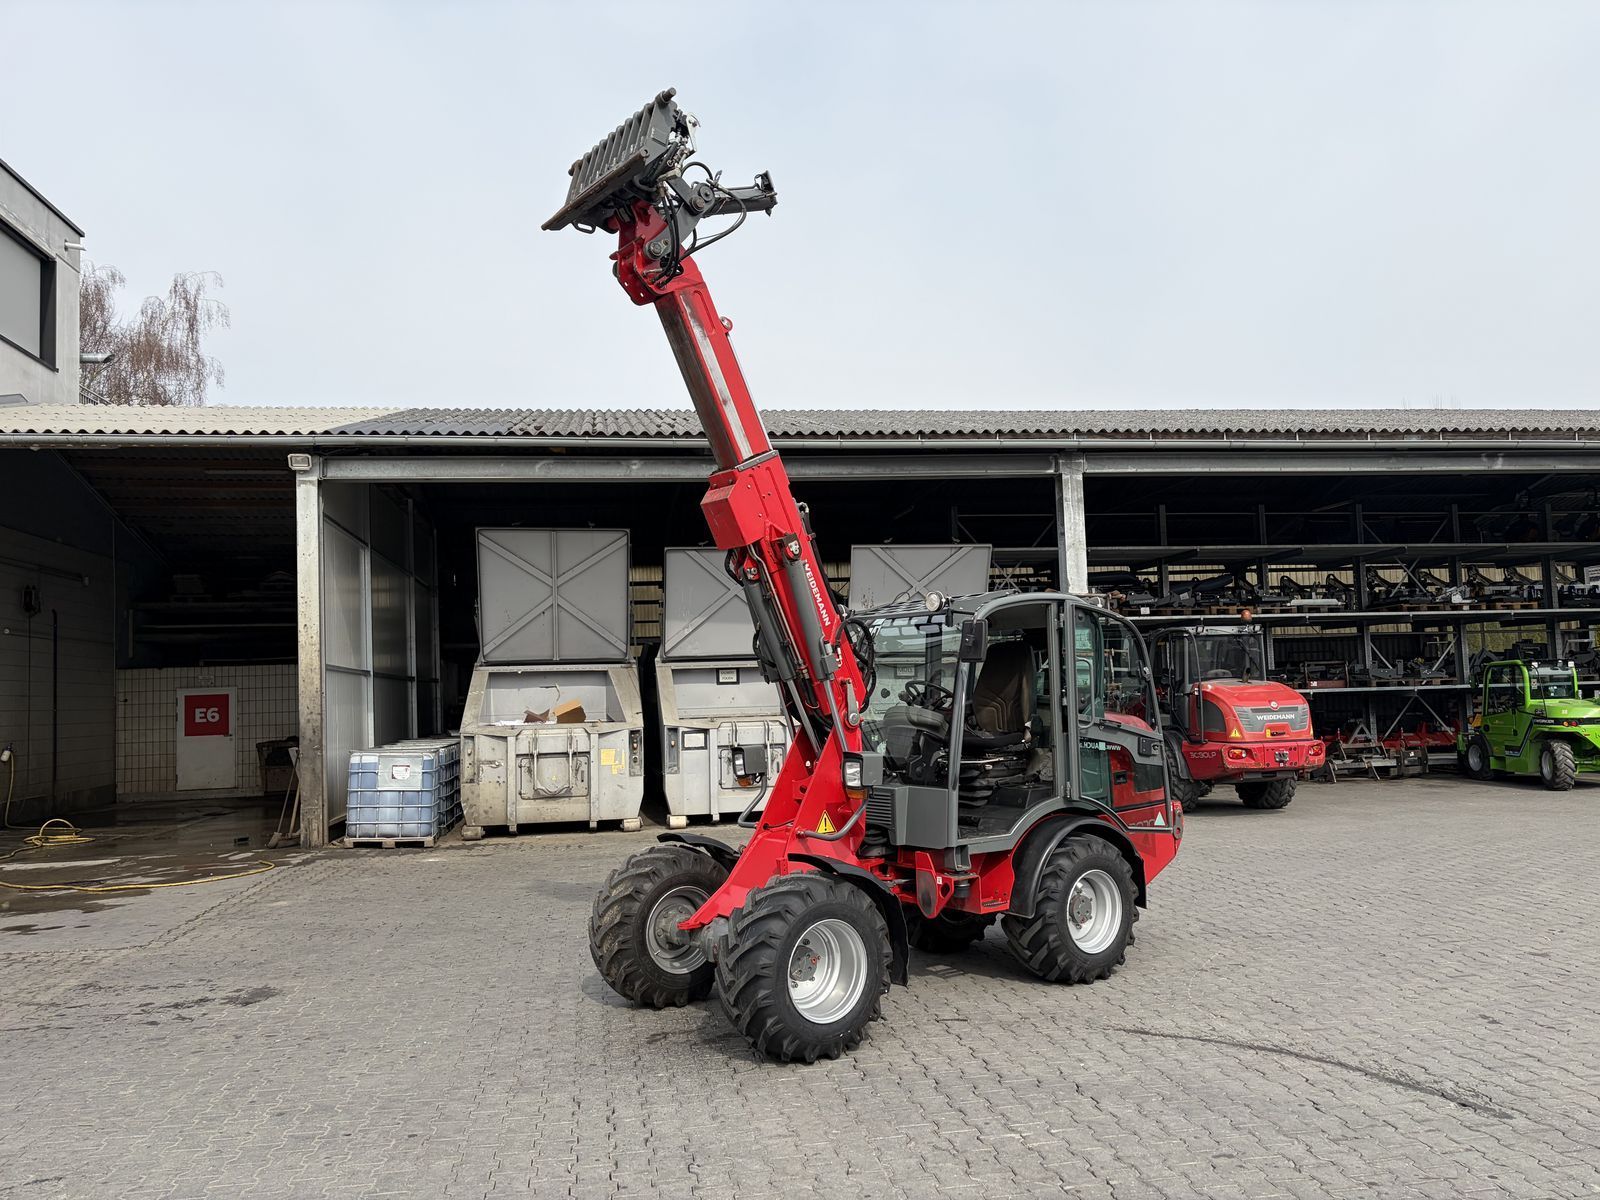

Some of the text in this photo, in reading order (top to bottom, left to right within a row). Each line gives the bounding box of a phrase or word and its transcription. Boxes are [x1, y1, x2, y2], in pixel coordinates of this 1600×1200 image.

[804, 559, 831, 626] WEIDEMANN
[194, 707, 220, 723] E6
[1256, 713, 1295, 721] WEIDEMANN
